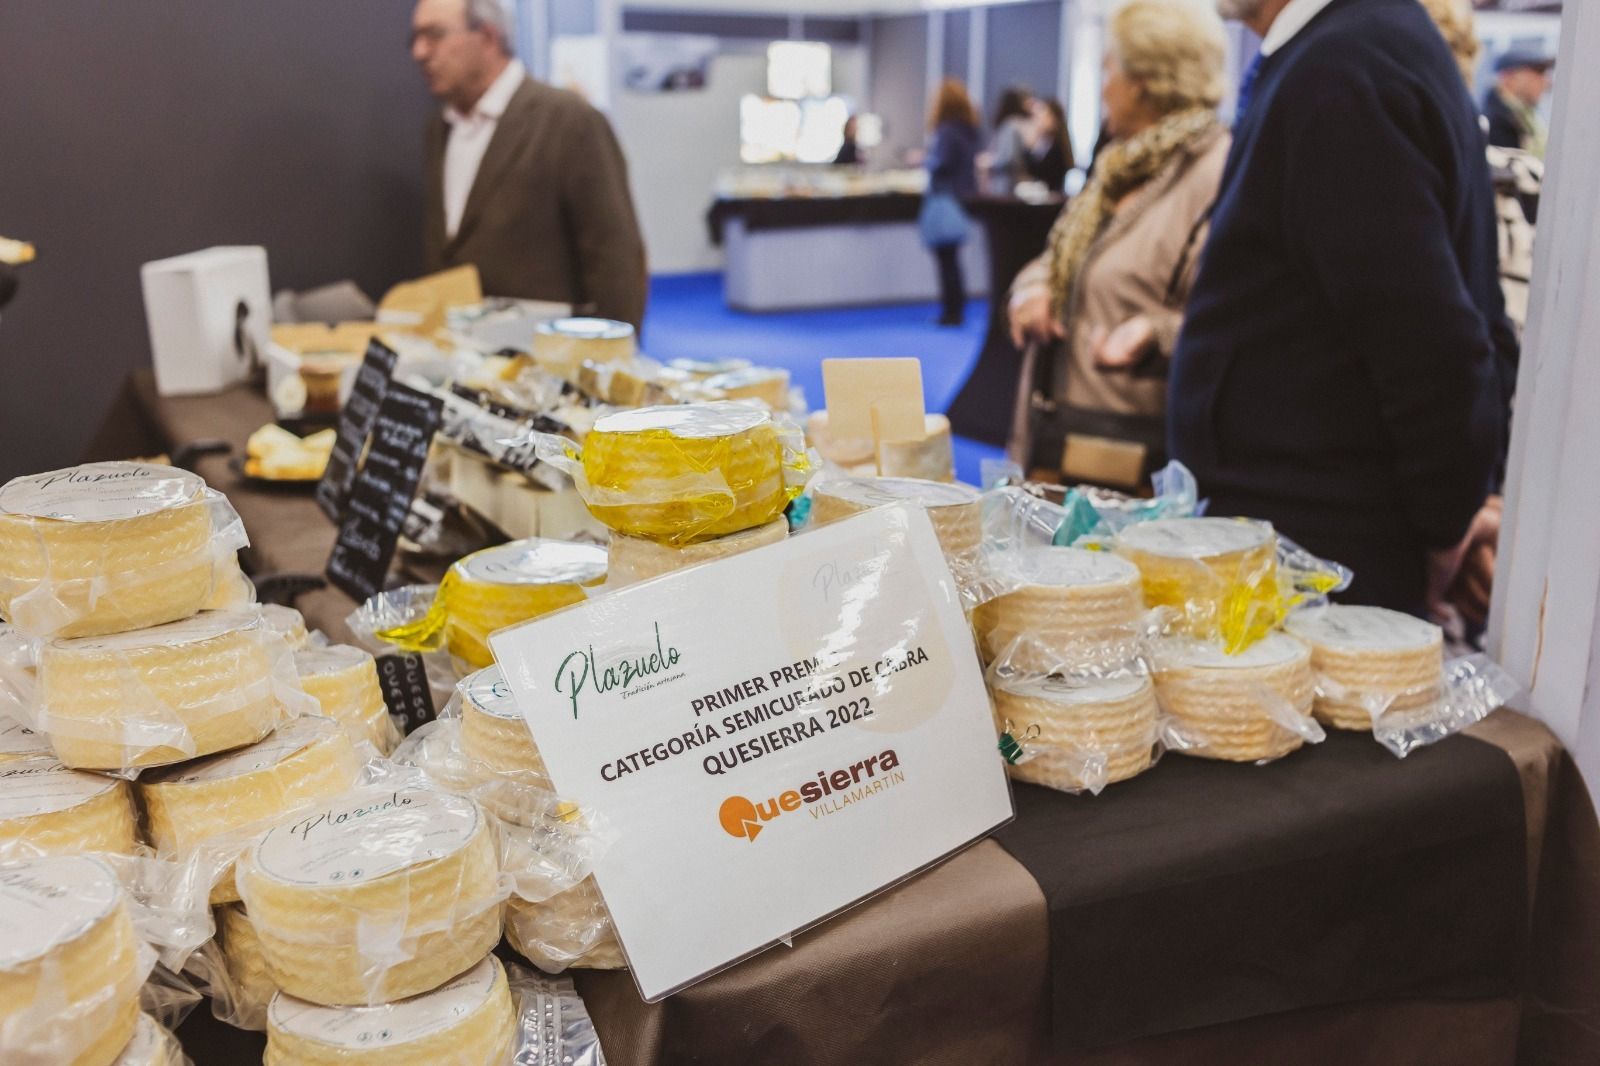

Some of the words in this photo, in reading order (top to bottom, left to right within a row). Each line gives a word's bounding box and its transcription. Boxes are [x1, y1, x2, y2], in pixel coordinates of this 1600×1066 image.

[35, 466, 150, 489] Plazuelo
[555, 621, 680, 720] Plazuelo
[691, 676, 770, 716] PRIMER
[769, 651, 841, 687] PREM
[600, 723, 721, 781] CATEGORÍA
[722, 676, 846, 734] SEMICURADO
[848, 666, 874, 687] DE
[702, 716, 825, 776] QUESIERRA
[826, 697, 874, 729] 2022
[291, 792, 412, 840] Plazuelo
[719, 749, 899, 843] Quesierra
[809, 771, 905, 820] VILLAMARTÍN
